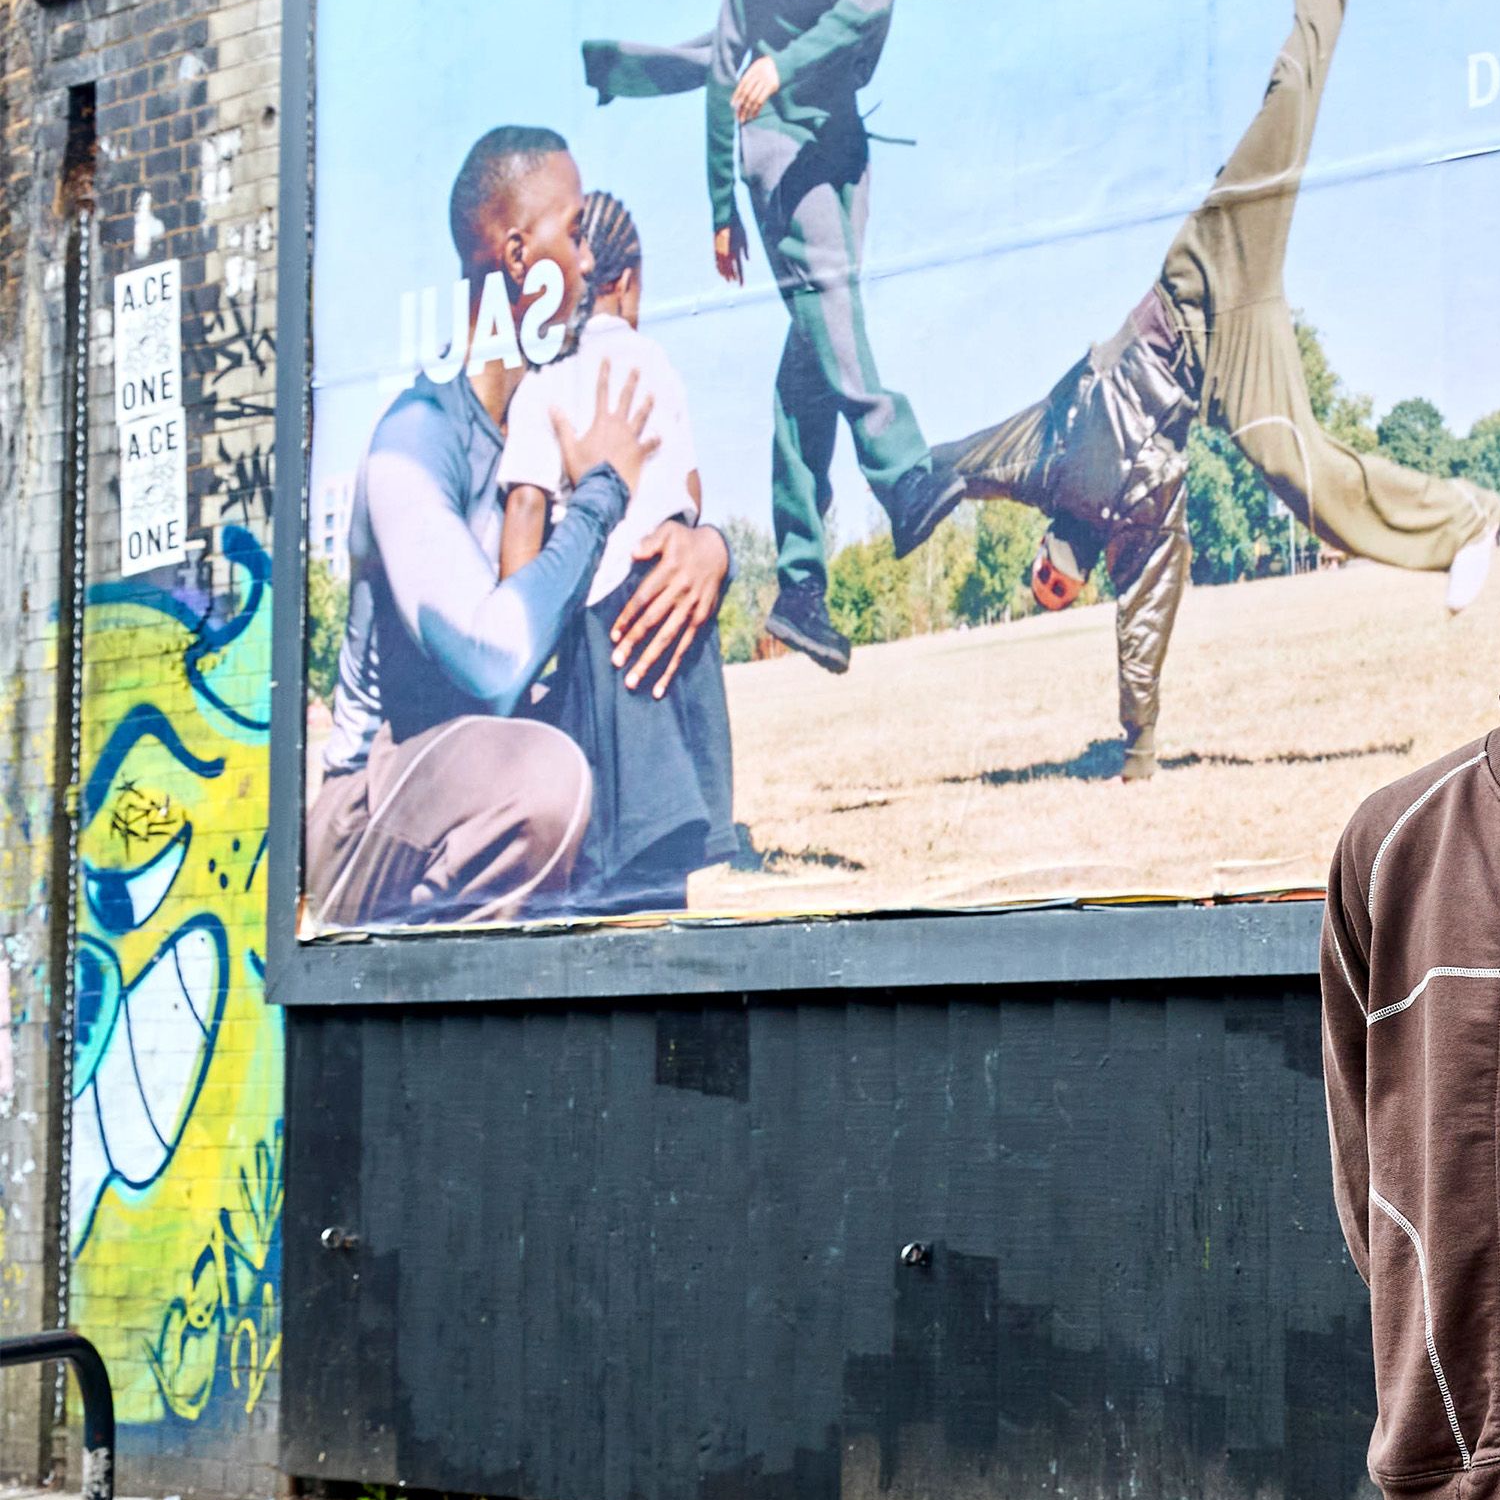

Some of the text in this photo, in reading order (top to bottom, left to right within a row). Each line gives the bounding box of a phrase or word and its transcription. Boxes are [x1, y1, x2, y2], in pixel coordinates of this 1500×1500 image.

[122, 270, 173, 313] A.CE
[122, 369, 174, 411] ONE
[127, 419, 179, 462] A.CE
[128, 519, 180, 561] ONE
